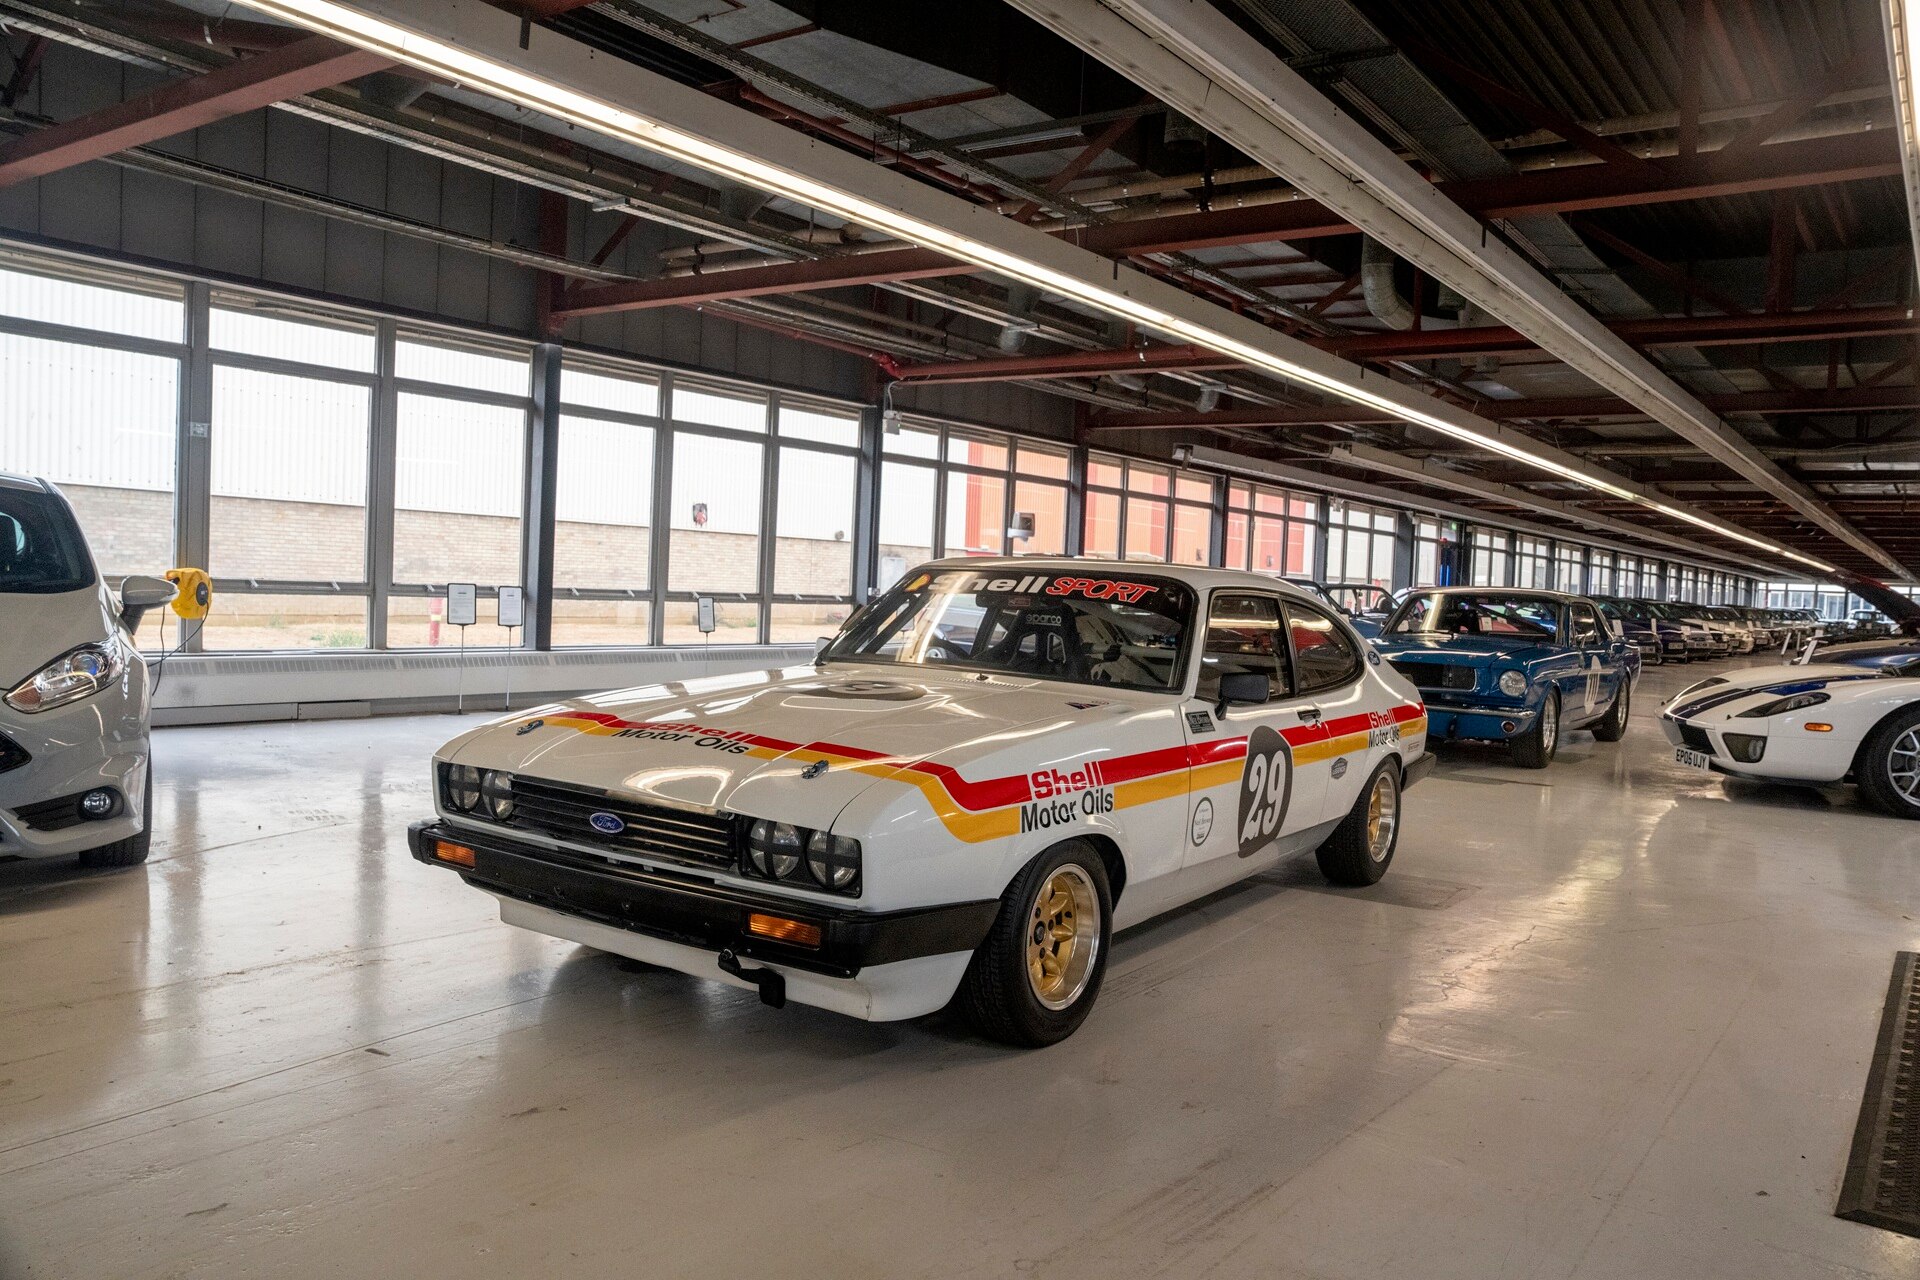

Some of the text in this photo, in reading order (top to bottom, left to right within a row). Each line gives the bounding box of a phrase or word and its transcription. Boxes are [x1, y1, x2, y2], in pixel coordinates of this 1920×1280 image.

[927, 574, 1160, 604] Shell SPORT
[652, 722, 757, 743] Shell
[1369, 708, 1395, 729] Shell
[611, 728, 750, 754] Motor Oils
[1693, 753, 1706, 769] UJY
[1031, 761, 1102, 800] Shell
[1021, 788, 1114, 833] Motor Oils
[1240, 750, 1287, 844] 29
